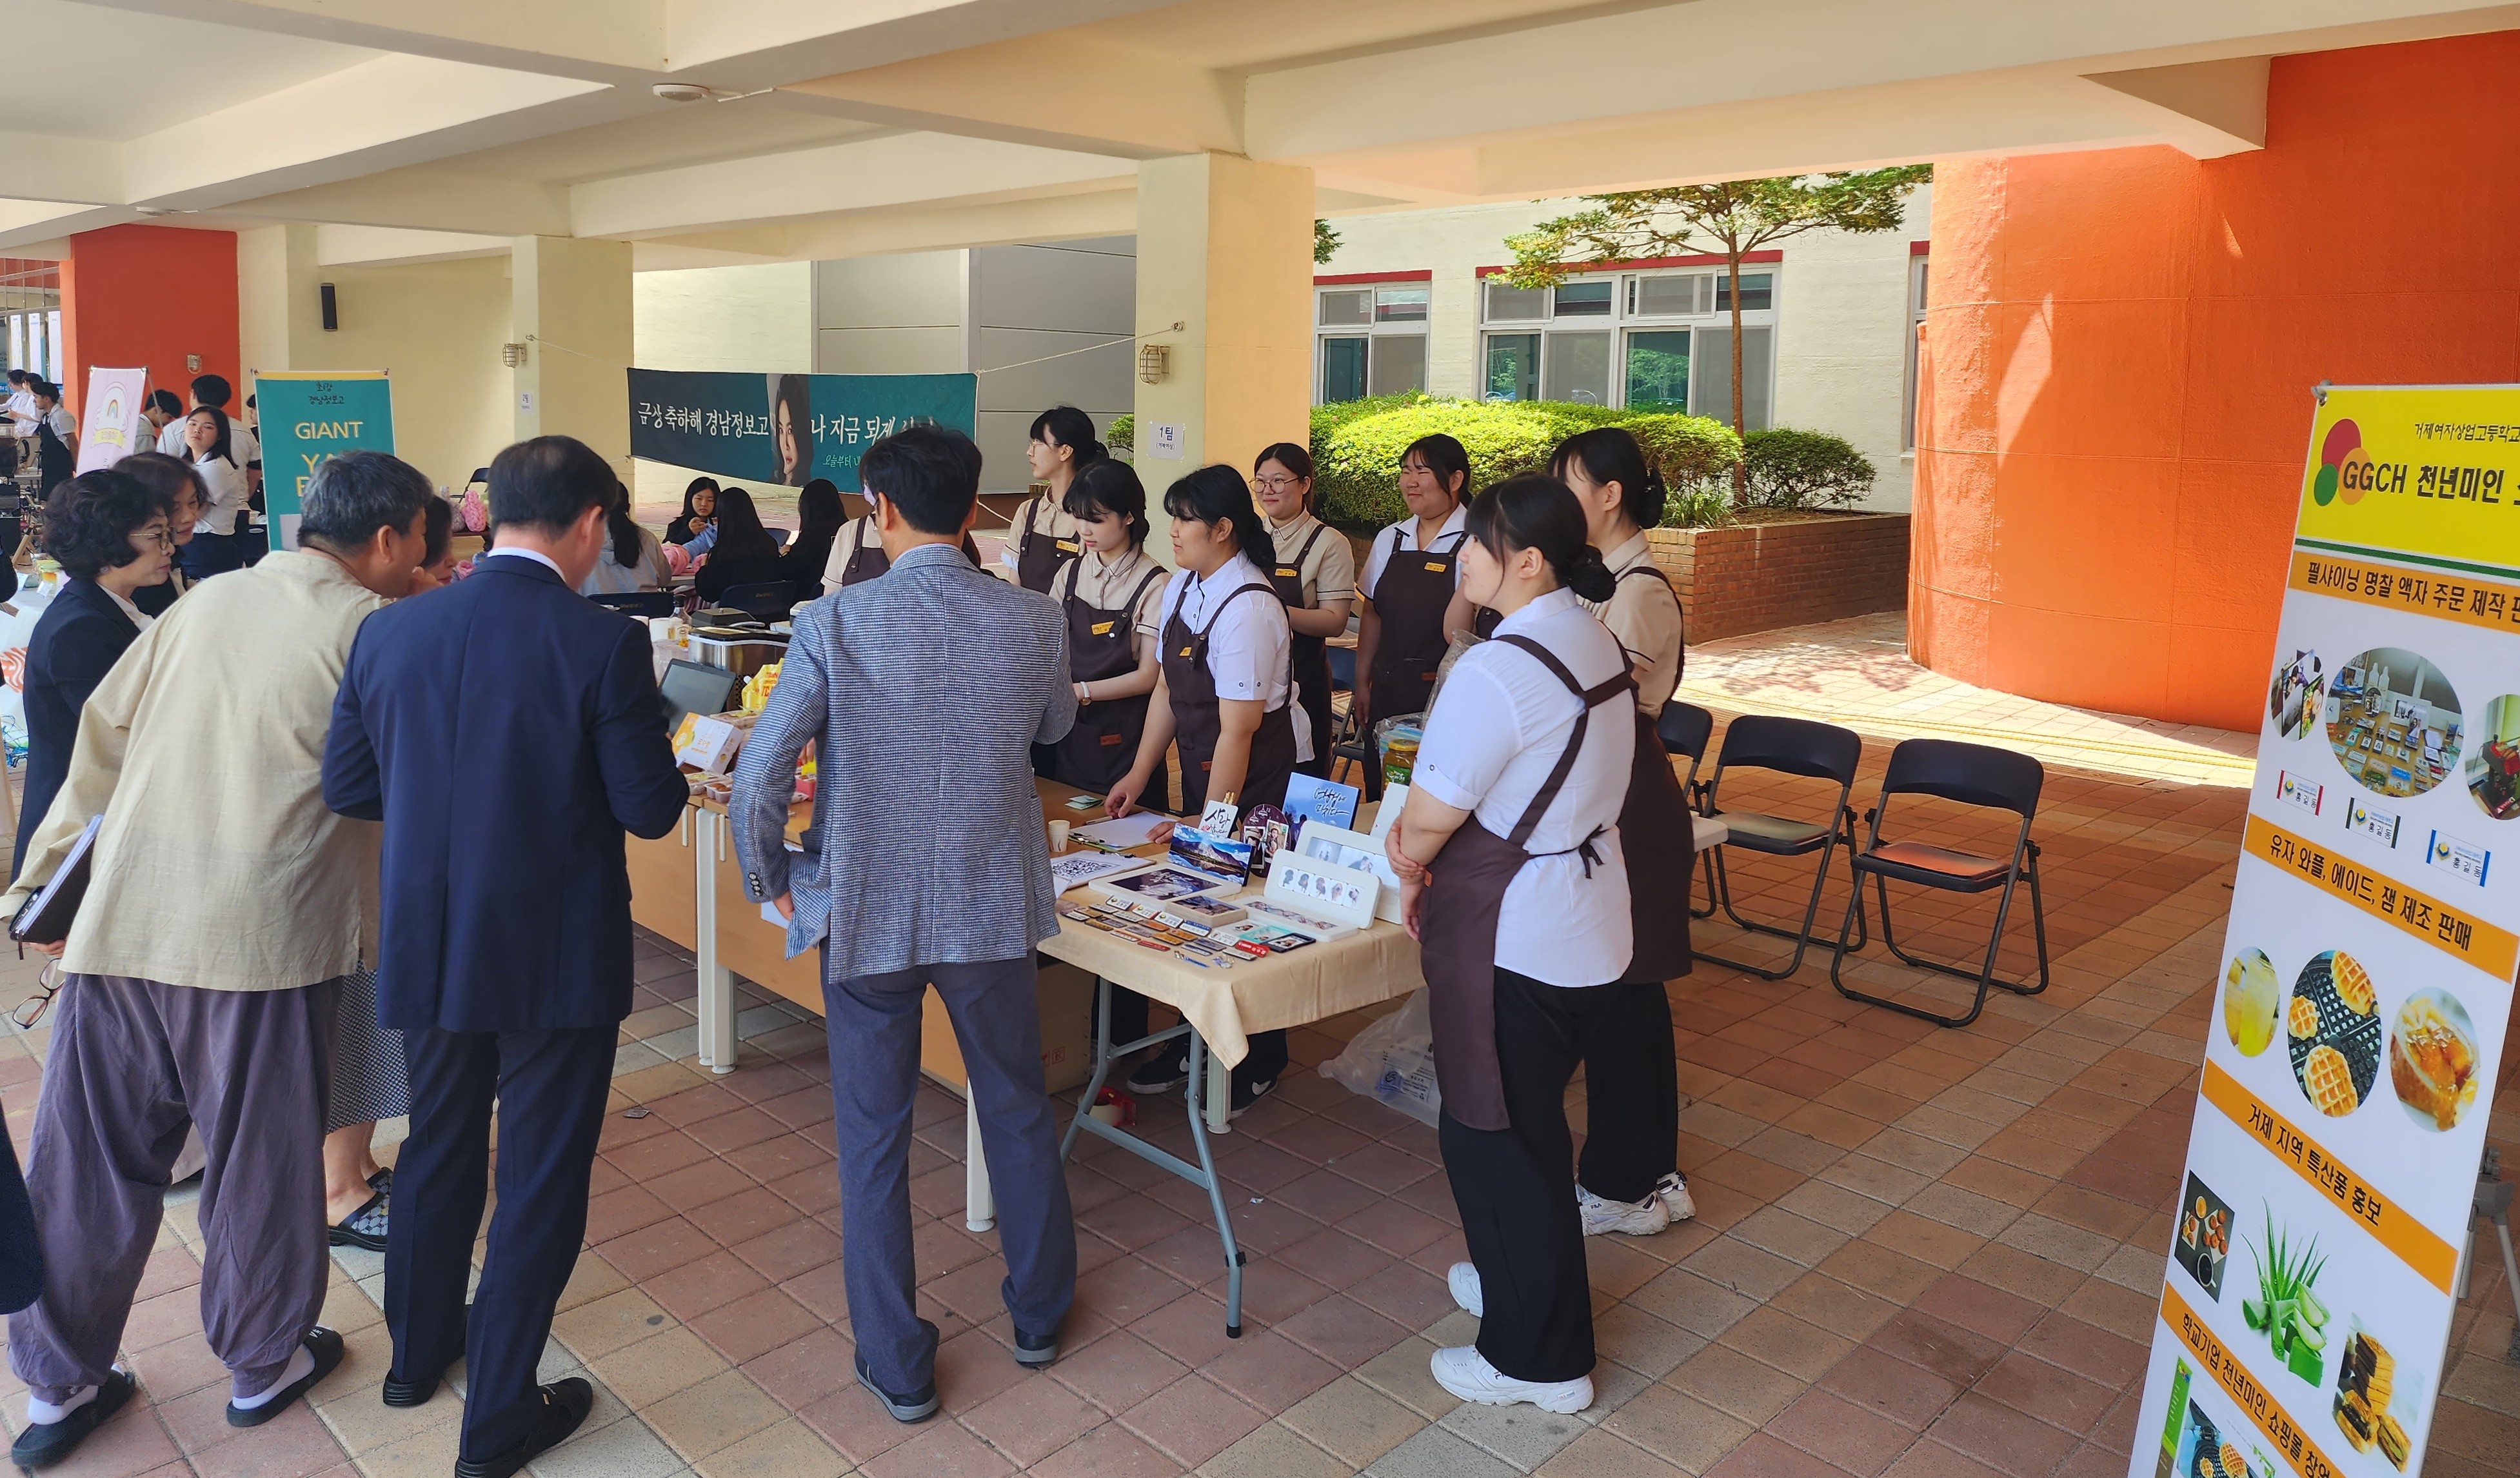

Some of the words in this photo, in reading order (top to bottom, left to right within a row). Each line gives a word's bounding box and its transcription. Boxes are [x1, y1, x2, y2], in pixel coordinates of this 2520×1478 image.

[308, 395, 344, 404] 경남정보고
[294, 421, 364, 439] GIANT
[637, 402, 663, 428] 금상
[664, 406, 702, 435] 축하해
[706, 409, 769, 438] 경남정보고
[811, 414, 826, 443] 나
[829, 414, 860, 444] 지금
[1160, 426, 1173, 441] 1팀
[2414, 423, 2520, 443] 거제여자상업고등학교
[822, 454, 851, 468] 오늘부터
[2343, 461, 2408, 494] GGCH
[2417, 465, 2505, 504] 천년미인
[2364, 571, 2394, 599] 명찰
[2398, 577, 2428, 605] 액자
[2433, 583, 2465, 612] 주문
[2469, 588, 2506, 619] 제작
[1204, 808, 1231, 828] 사랑
[2270, 834, 2295, 864] 유자
[2297, 847, 2327, 881] 와플,
[2330, 861, 2376, 906] 에이드,
[2381, 885, 2397, 915] 잼
[2399, 894, 2432, 932] 제조
[2437, 912, 2473, 952] 판매
[2248, 1103, 2274, 1141] 거제
[2276, 1125, 2304, 1164] 지역
[2307, 1148, 2348, 1201] 특산품
[2352, 1185, 2382, 1227] 홍보
[2182, 1312, 2221, 1372] 학교기업
[2222, 1357, 2268, 1422] 천년미인
[2268, 1411, 2303, 1463] 쇼핑몰
